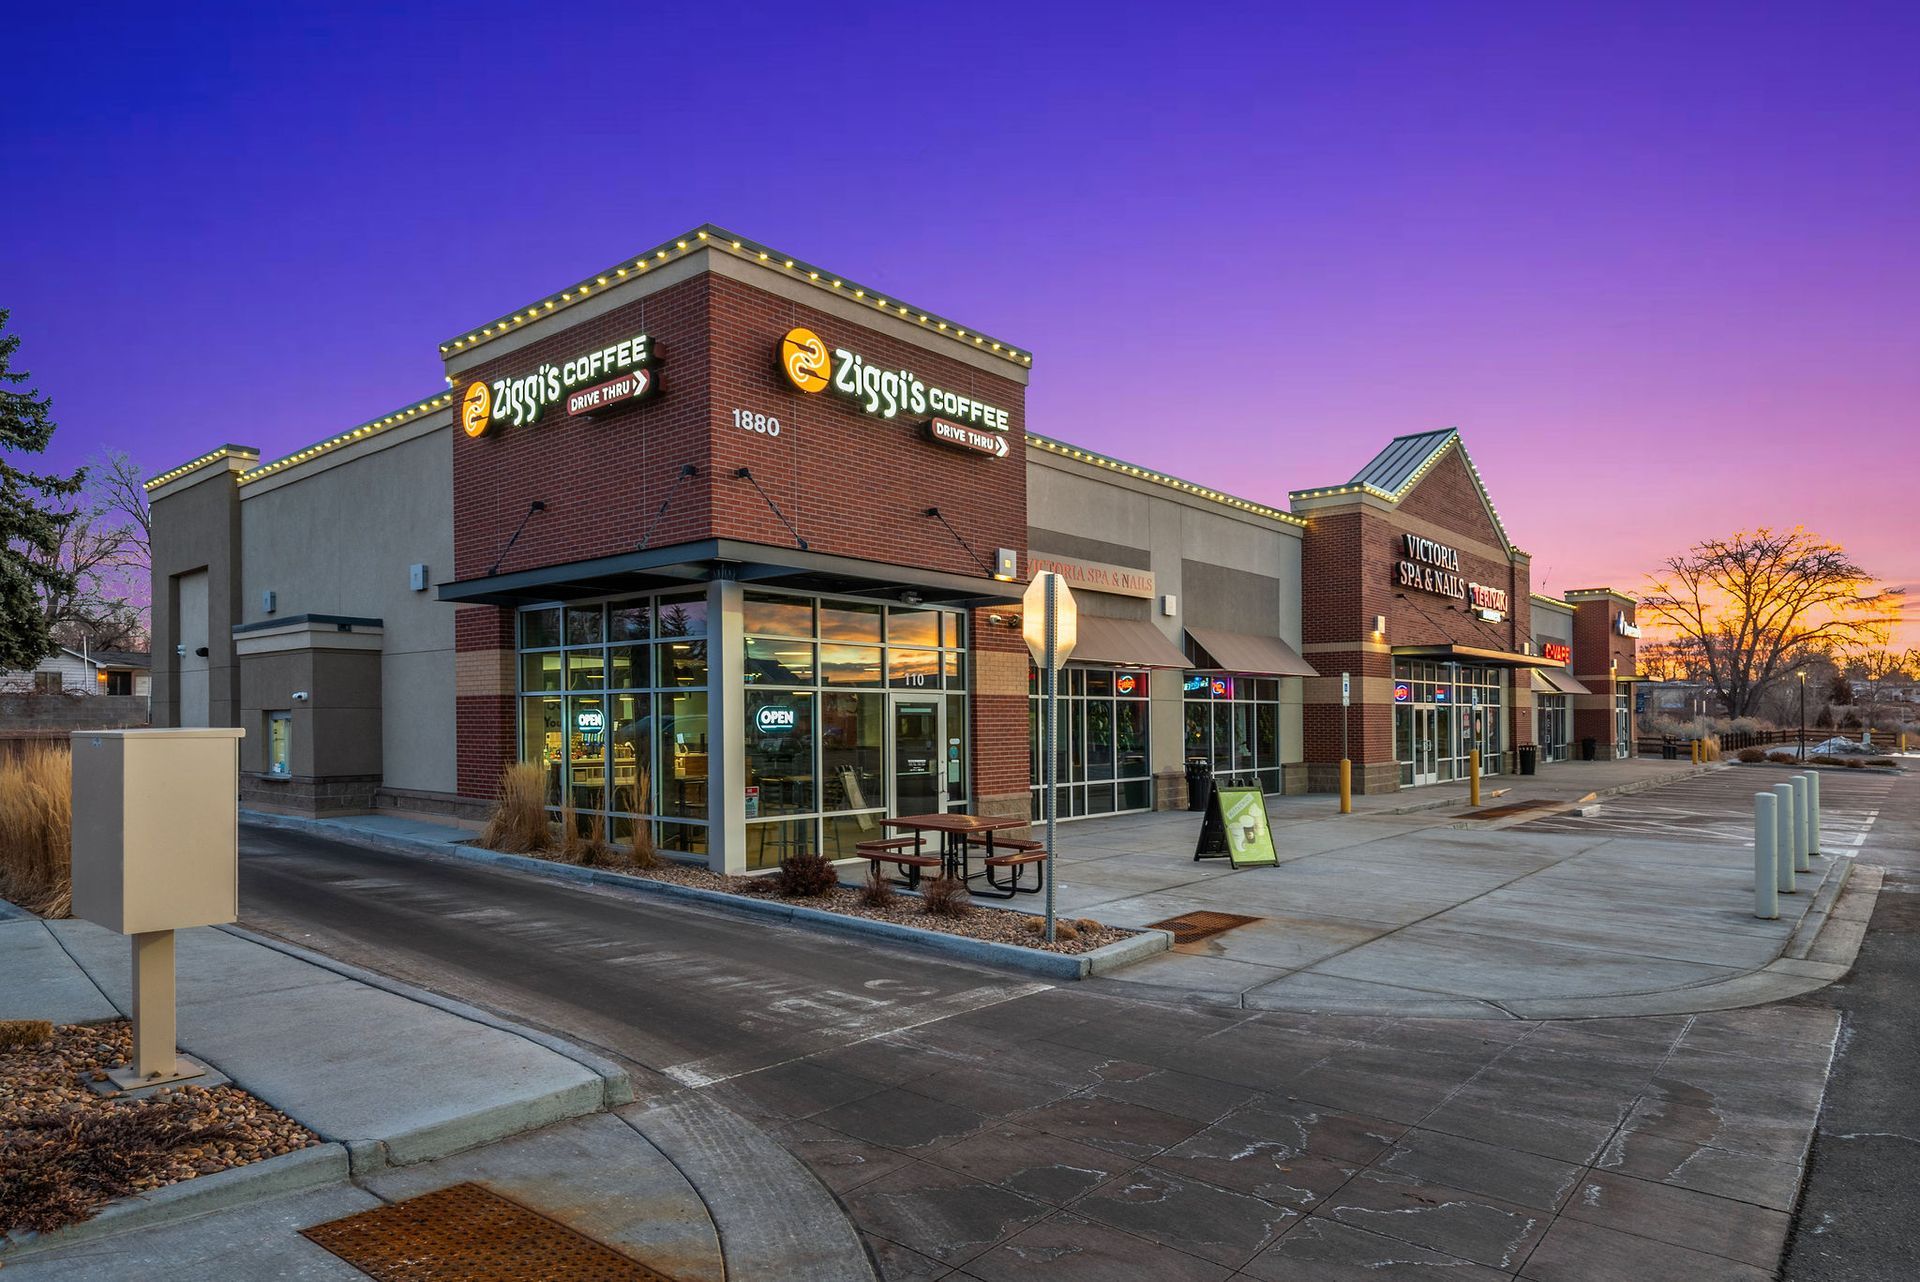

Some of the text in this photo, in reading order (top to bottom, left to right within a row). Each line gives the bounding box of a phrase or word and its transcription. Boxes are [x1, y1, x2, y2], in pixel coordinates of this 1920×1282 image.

[492, 334, 647, 427] Ziggi's COFFEE
[835, 348, 1009, 431] Ziggi's COFFEE
[570, 380, 630, 412] DRIVE THRU
[732, 408, 780, 437] 1880
[936, 422, 994, 450] DRIVE THRU
[1406, 533, 1459, 572] VICTORIA
[1086, 567, 1111, 586] SPA
[1112, 571, 1120, 587] &
[1121, 573, 1153, 592] NAILS
[1400, 560, 1465, 600] SPA & NAILS
[1473, 584, 1508, 612] TERIYAKI
[904, 672, 925, 687] 110
[578, 713, 603, 727] OPEN
[760, 710, 794, 724] OPEN
